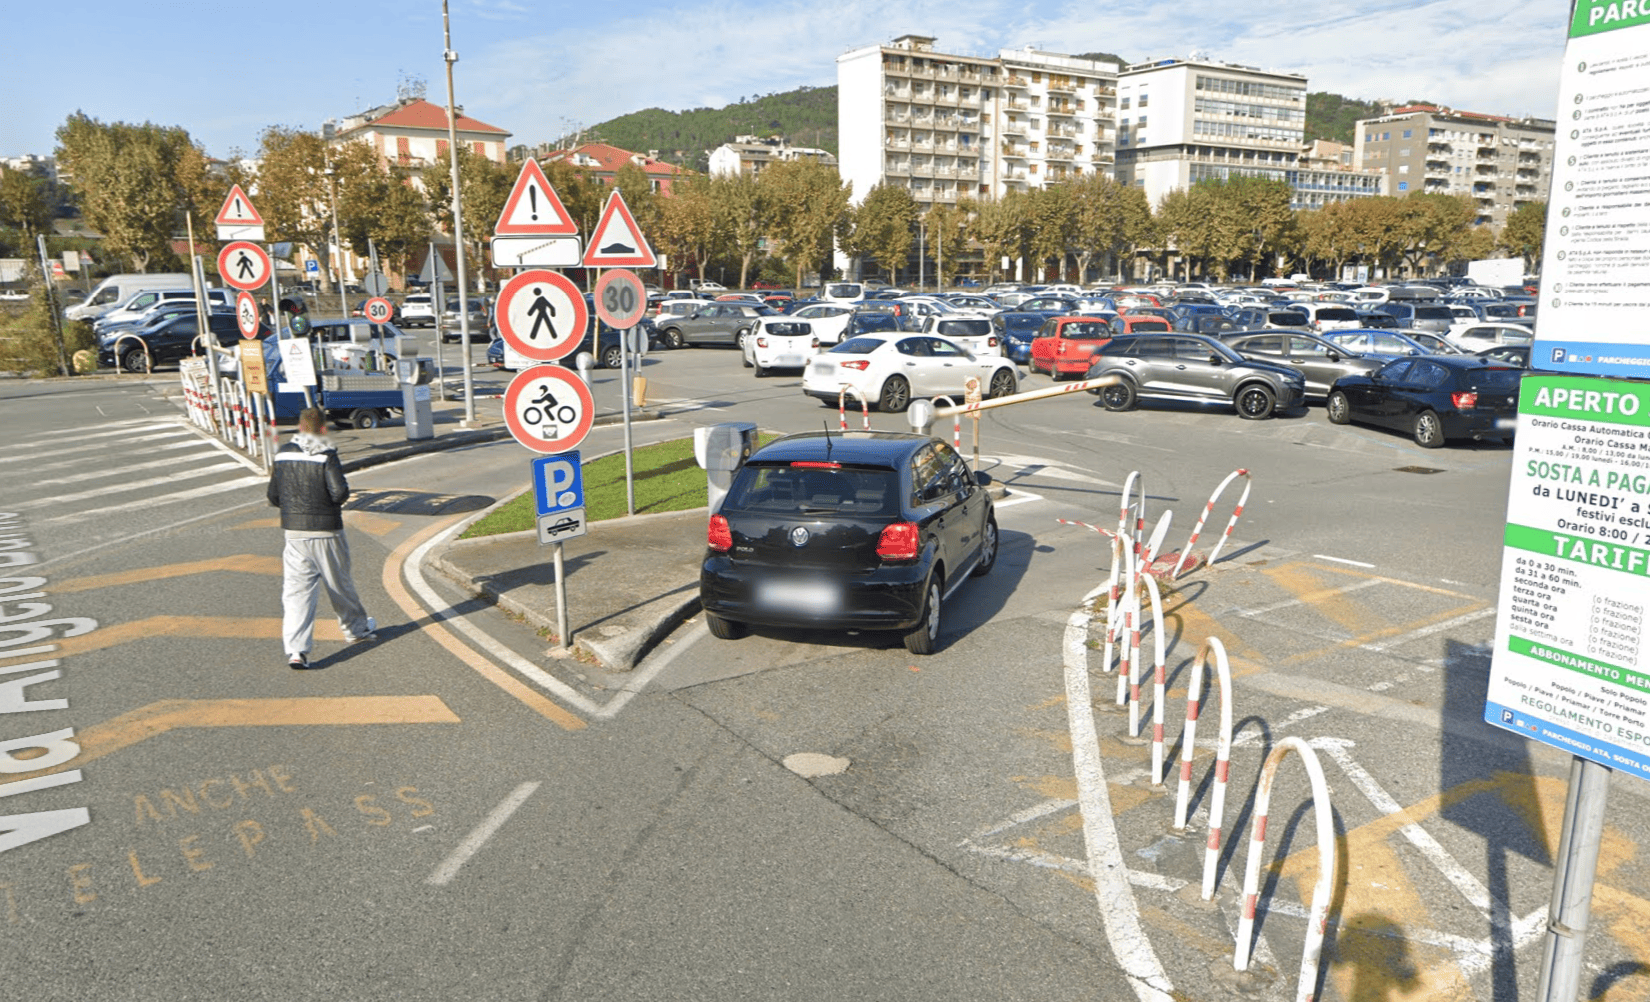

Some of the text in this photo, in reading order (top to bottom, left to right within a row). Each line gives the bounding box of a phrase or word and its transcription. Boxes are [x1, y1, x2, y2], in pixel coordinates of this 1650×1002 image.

[606, 286, 634, 313] 30
[371, 305, 386, 317] 30
[1554, 350, 1564, 361] P
[1534, 386, 1640, 416] APERTO
[1532, 418, 1644, 438] Orario Cassa Automatica
[1574, 436, 1604, 446] Orario
[1608, 439, 1636, 450] Cassa
[544, 460, 574, 508] P
[1527, 460, 1582, 484] SOSTA
[1588, 469, 1600, 488] A
[1532, 484, 1550, 498] da
[1631, 502, 1640, 512] a
[1576, 506, 1615, 522] festivi
[1558, 518, 1595, 534] Orario
[1599, 526, 1628, 540] 8:00
[1552, 535, 1650, 576] TARIF
[1516, 557, 1526, 565] da
[1544, 563, 1555, 571] 30
[1558, 568, 1577, 577] min.
[1514, 577, 1565, 594] seconda ora
[1528, 569, 1538, 578] 31
[1548, 574, 1559, 582] 60
[1562, 579, 1581, 588] min.
[1514, 585, 1551, 600] terza ora
[1511, 604, 1554, 621] quinta ora
[1512, 595, 1557, 612] quarta ora
[1511, 614, 1549, 629] sesta ora
[1560, 638, 1573, 646] ora
[1530, 646, 1620, 680] ABBONAMENTO
[1504, 676, 1526, 689] Popolo
[1535, 687, 1553, 698] Piave
[1562, 696, 1590, 709] Priamar
[1600, 708, 1620, 719] Torre
[1623, 716, 1645, 728] Porto
[1552, 681, 1575, 694] Popolo
[1584, 692, 1604, 704] Piave
[1614, 702, 1646, 716] Priamar
[1601, 686, 1647, 706] Solo Popolo
[1521, 695, 1612, 733] REGOLAMENTO
[1504, 711, 1512, 721] P
[1542, 729, 1592, 752] PARCHEGGIO
[1612, 754, 1640, 768] SOSTA
[1641, 762, 1650, 773] O
[132, 763, 297, 827] ANCHE
